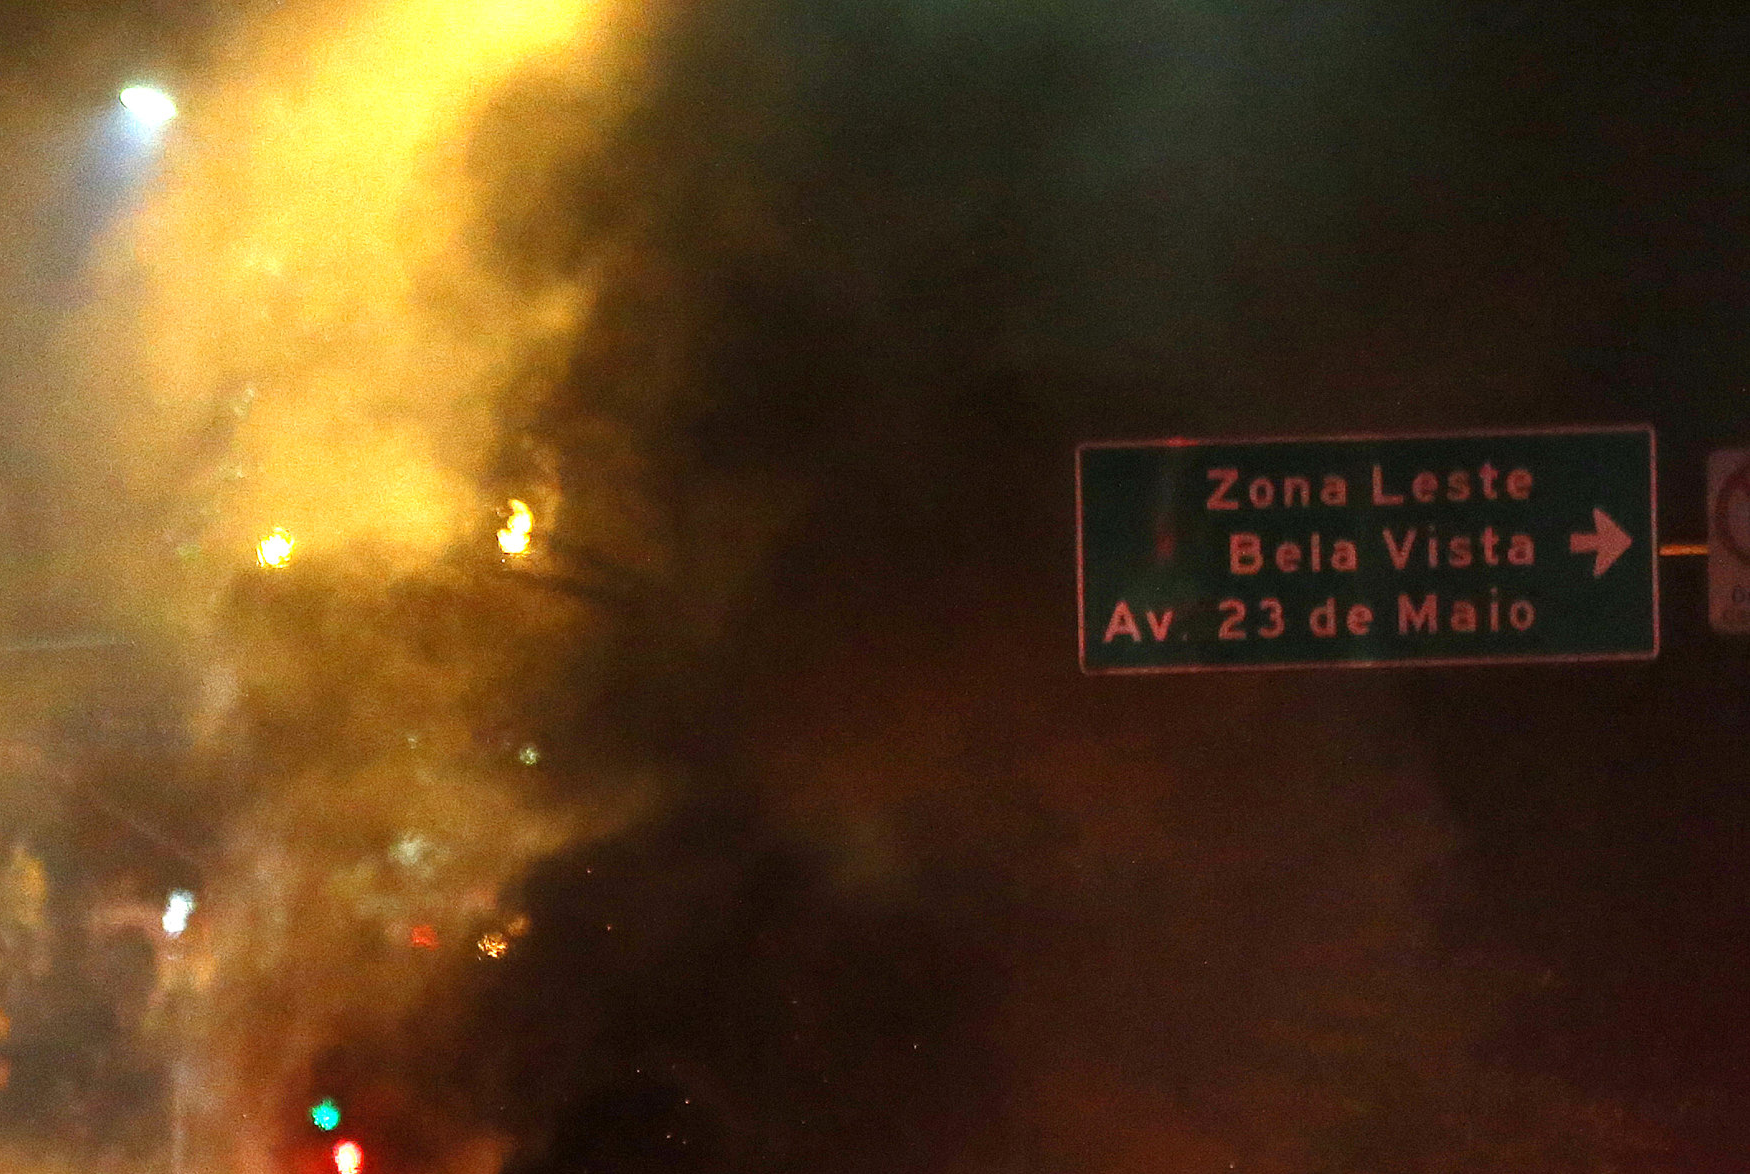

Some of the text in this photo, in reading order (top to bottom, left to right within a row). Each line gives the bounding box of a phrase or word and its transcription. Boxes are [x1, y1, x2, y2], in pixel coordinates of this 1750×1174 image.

[1206, 463, 1534, 510] Zona Leste
[1228, 523, 1536, 576] Bela Vista
[1218, 597, 1286, 640] 23
[1309, 597, 1374, 637] de
[1397, 587, 1536, 636] Maio
